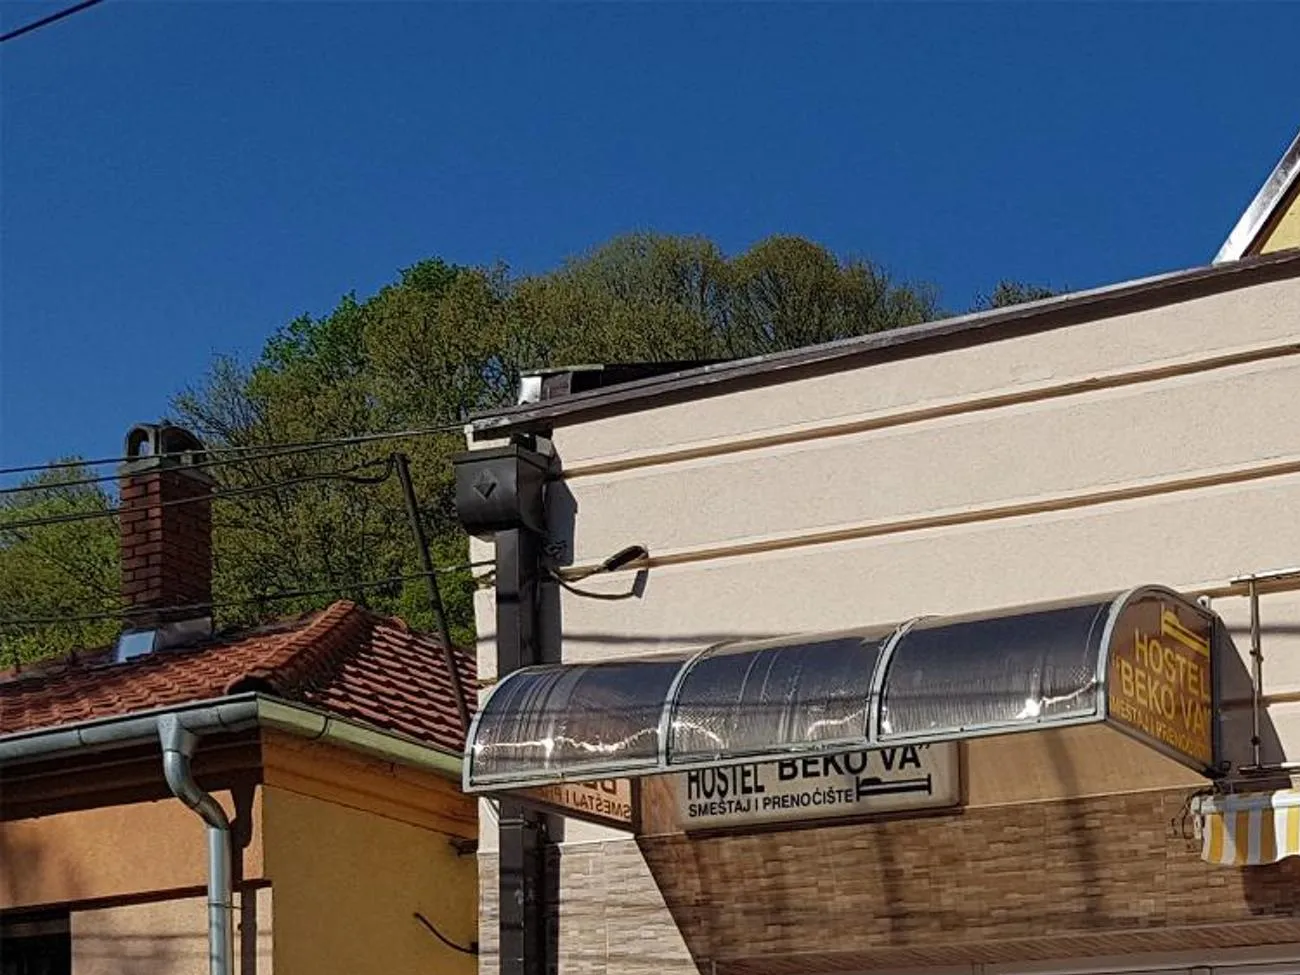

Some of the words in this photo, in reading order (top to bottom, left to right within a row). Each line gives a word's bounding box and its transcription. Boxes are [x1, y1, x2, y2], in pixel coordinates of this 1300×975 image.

[1134, 627, 1210, 699] HOSTEL
[1109, 695, 1151, 734] MEŠTAJ
[687, 763, 765, 800] HOSTEL
[771, 751, 868, 781] BEKO
[688, 796, 752, 817] SMEŠTAJ
[755, 800, 759, 812] I
[762, 787, 854, 810] PRENOĆIŠTE
